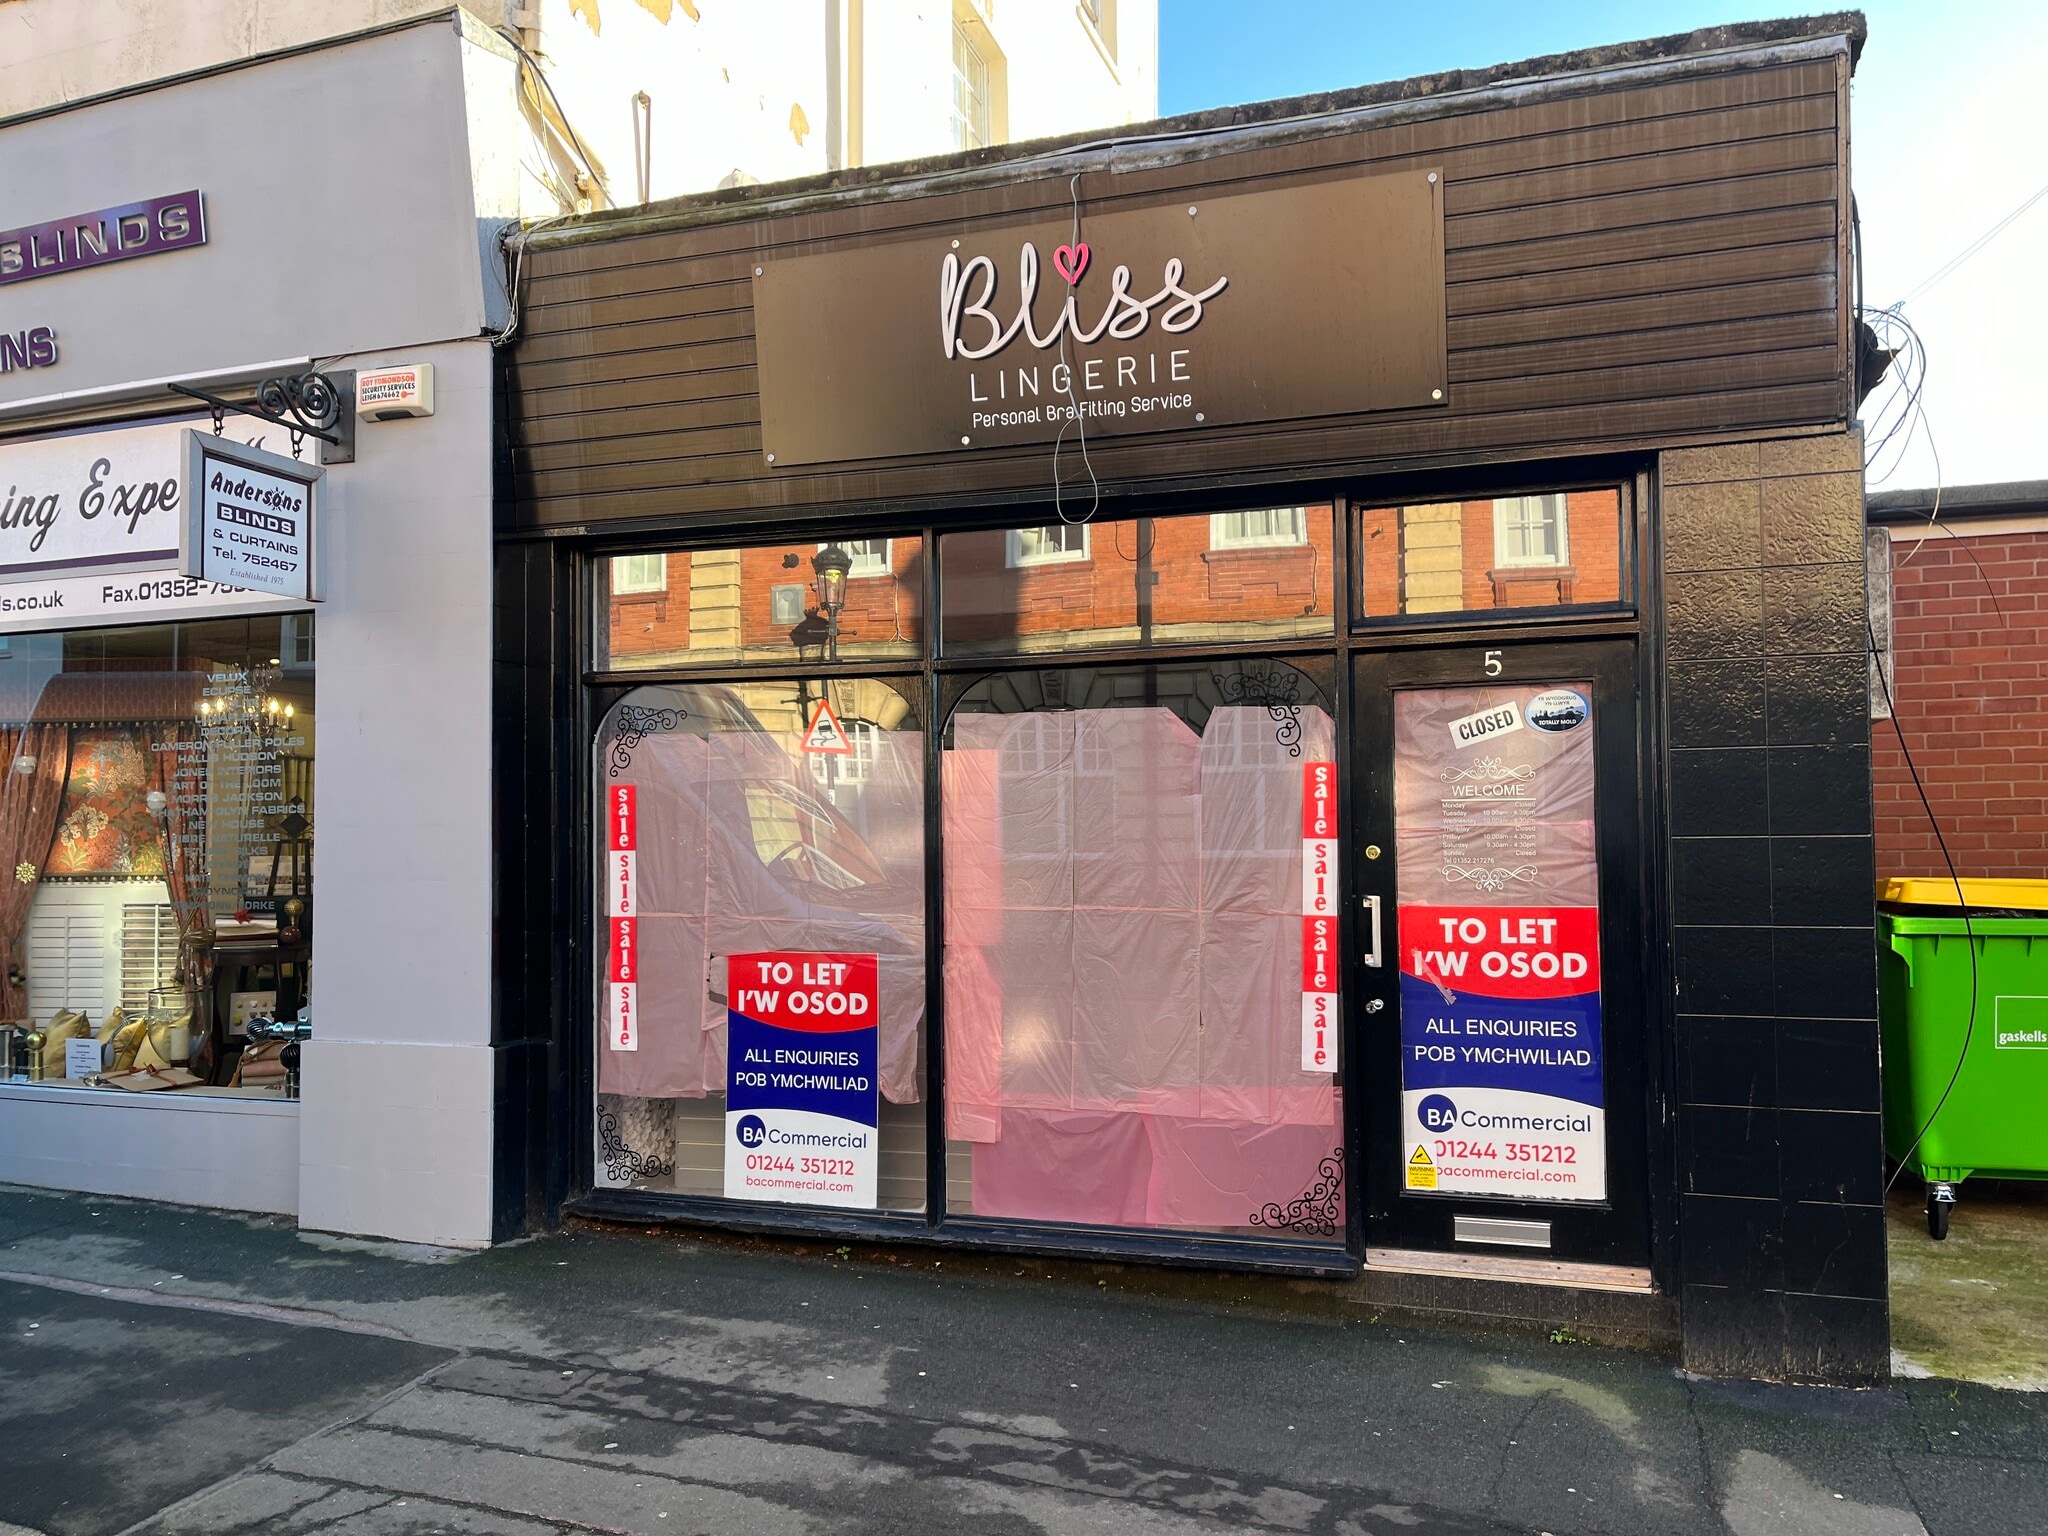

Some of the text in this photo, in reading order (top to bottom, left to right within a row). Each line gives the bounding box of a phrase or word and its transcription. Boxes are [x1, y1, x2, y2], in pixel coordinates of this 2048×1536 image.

[0, 203, 191, 274] BLINDS
[941, 242, 1228, 359] Bliss
[0, 326, 56, 372] NS
[971, 349, 1191, 401] LINGERIE
[362, 382, 415, 395] SECURITY SERVICES
[362, 391, 400, 402] LEIGH 674662
[973, 393, 1192, 428] Personal Bra Fitting Service
[79, 457, 180, 534] Expe
[211, 471, 302, 513] Andersons
[221, 505, 293, 534] BLINDS
[213, 528, 298, 555] & CURTAINS
[212, 546, 298, 573] Tel. 752467
[230, 567, 284, 586] Established 1975
[0, 590, 63, 612] s.co.uk
[1484, 650, 1503, 677] 5
[207, 672, 248, 683] VELUX
[202, 685, 252, 697] ECLIPSE
[1459, 710, 1514, 740] CLOSED
[151, 740, 209, 752] CAMERON
[265, 736, 305, 747] POLES
[223, 751, 277, 761] HUDSON
[217, 765, 282, 775] INTERIORS
[173, 781, 196, 791] ART
[223, 792, 283, 802] JACKSON
[1451, 784, 1525, 797] WELCOME
[251, 805, 305, 815] FABRICS
[1314, 766, 1328, 835] sale
[223, 819, 265, 829] HOUSE
[617, 788, 629, 848] sale
[620, 854, 629, 913] sale
[1314, 843, 1328, 912] sale
[1439, 918, 1557, 945] TO LET
[620, 919, 630, 980] sale
[1314, 918, 1328, 989] sale
[757, 961, 846, 986] TO LET
[1414, 951, 1588, 979] I'W OSOD
[738, 990, 868, 1016] I'W OSOD
[620, 986, 630, 1046] sale
[1425, 1018, 1577, 1038] ALL ENQUIRIES
[1314, 996, 1327, 1066] sale
[1999, 1030, 2047, 1045] gaskells
[744, 1049, 859, 1066] ALL ENQUIRIES
[1414, 1045, 1591, 1066] POB YMCHWILIAD
[736, 1072, 868, 1091] POB YMCHWILIAD
[1427, 1108, 1592, 1133] BA Commercial
[743, 1127, 867, 1149] BA Commercial
[746, 1154, 855, 1176] 01244 351212
[1505, 1143, 1576, 1164] 351212
[746, 1175, 854, 1192] bacommercial.com
